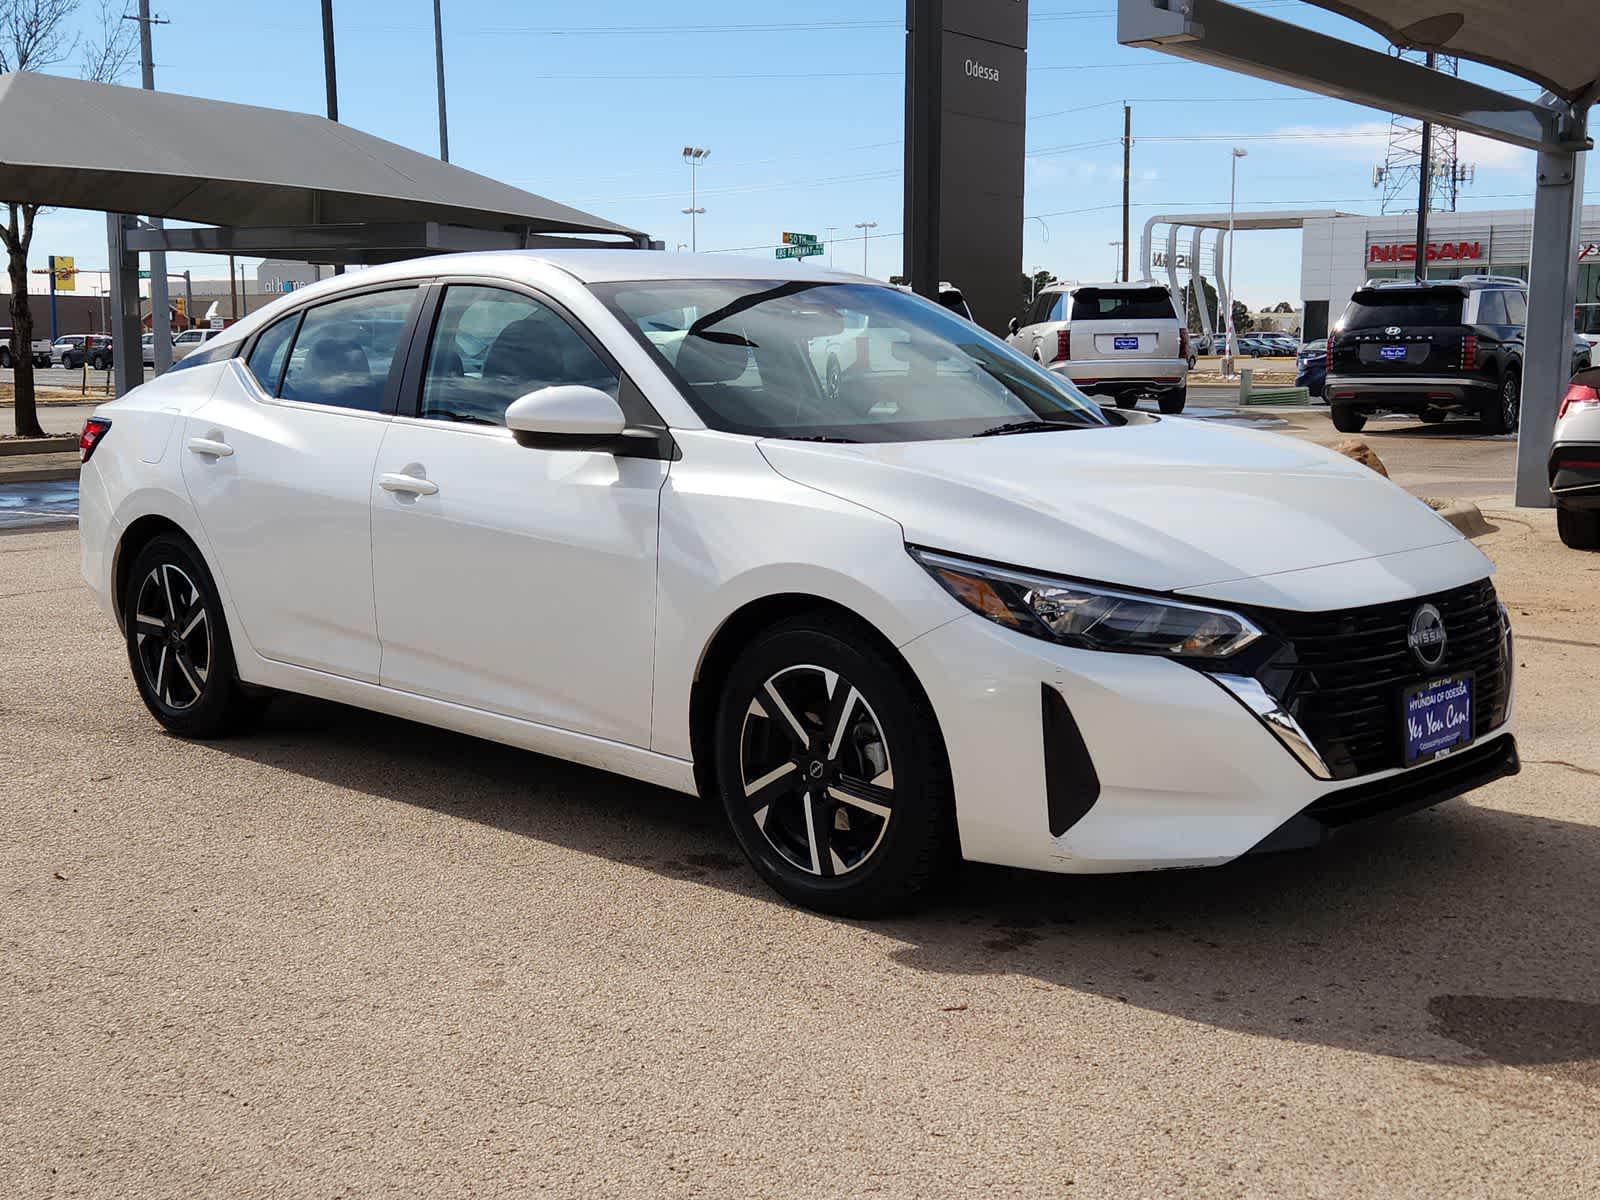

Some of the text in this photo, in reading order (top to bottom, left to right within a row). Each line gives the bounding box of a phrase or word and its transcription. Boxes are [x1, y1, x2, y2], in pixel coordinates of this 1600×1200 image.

[965, 59, 999, 82] Odessa
[1369, 241, 1480, 262] NISSAN
[1410, 684, 1468, 711] HYUNDAI OF ODESSA
[1408, 716, 1423, 742] Yes
[1426, 710, 1444, 735] You
[1446, 698, 1470, 729] Can!
